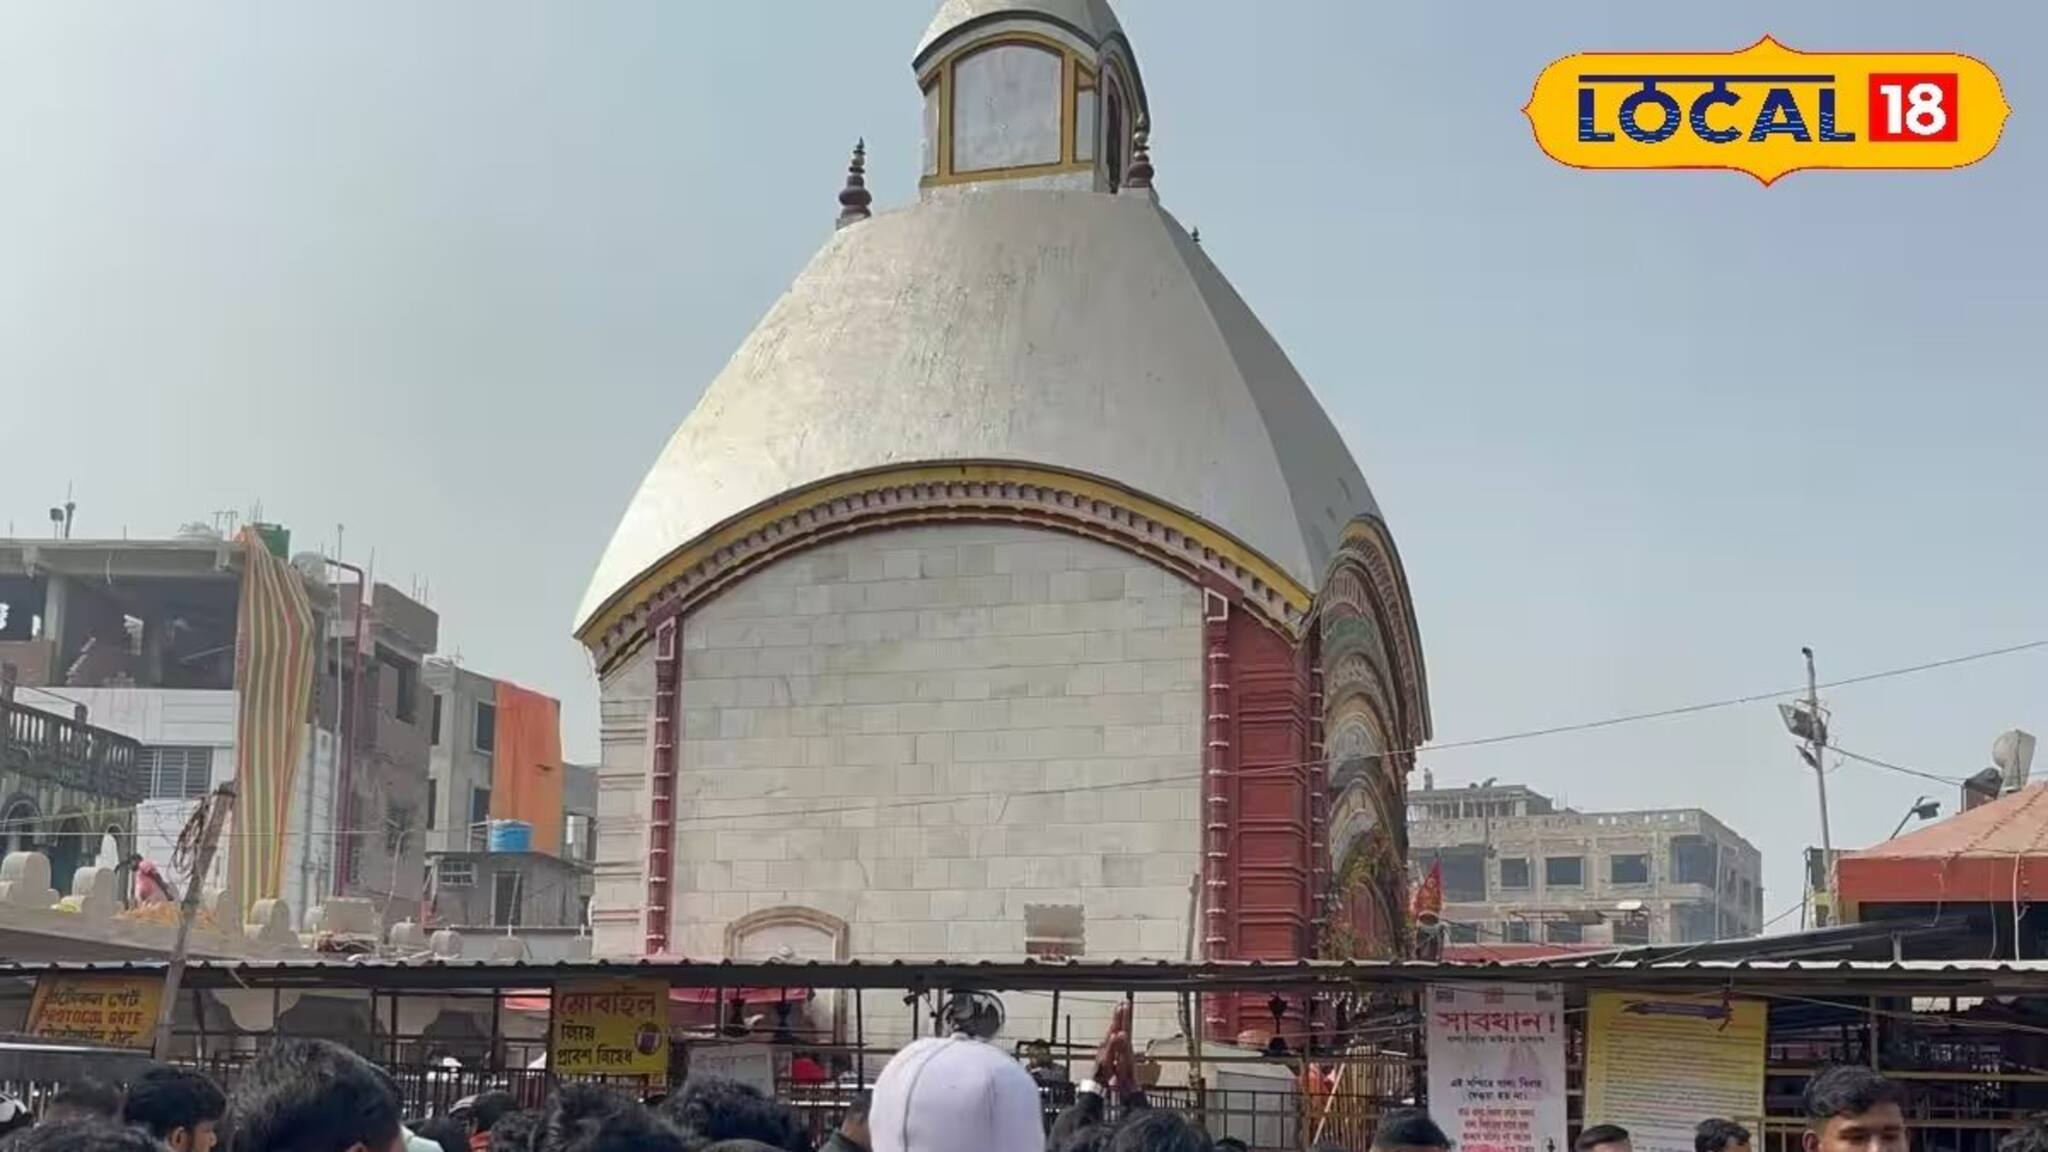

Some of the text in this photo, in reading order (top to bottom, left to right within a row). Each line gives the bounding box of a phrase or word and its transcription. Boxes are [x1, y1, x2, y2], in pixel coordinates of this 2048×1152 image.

[559, 985, 656, 1017] মোবাইল
[40, 1008, 143, 1025] PROTOCOL GATE
